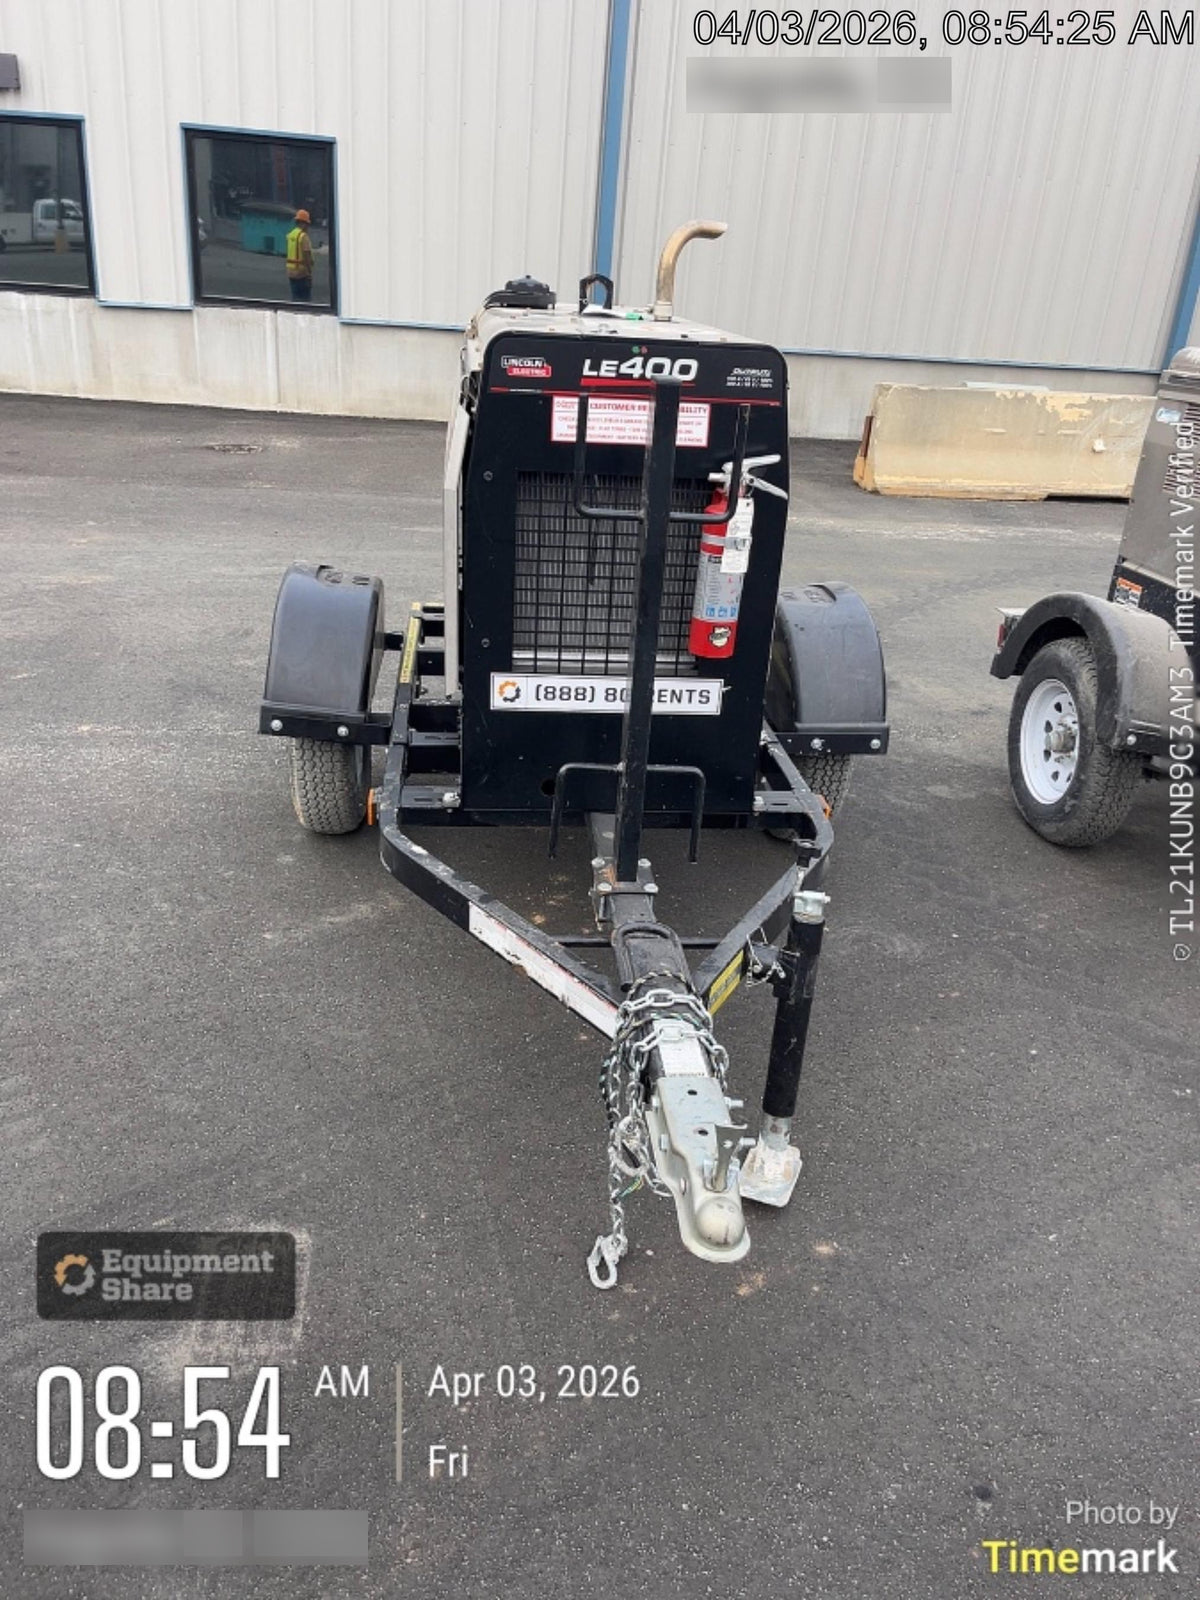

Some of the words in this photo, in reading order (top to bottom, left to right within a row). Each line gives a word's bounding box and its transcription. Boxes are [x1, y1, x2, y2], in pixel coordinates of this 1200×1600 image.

[502, 357, 544, 367] LINCOLN
[582, 356, 699, 381] LE400
[535, 684, 596, 703] (888)
